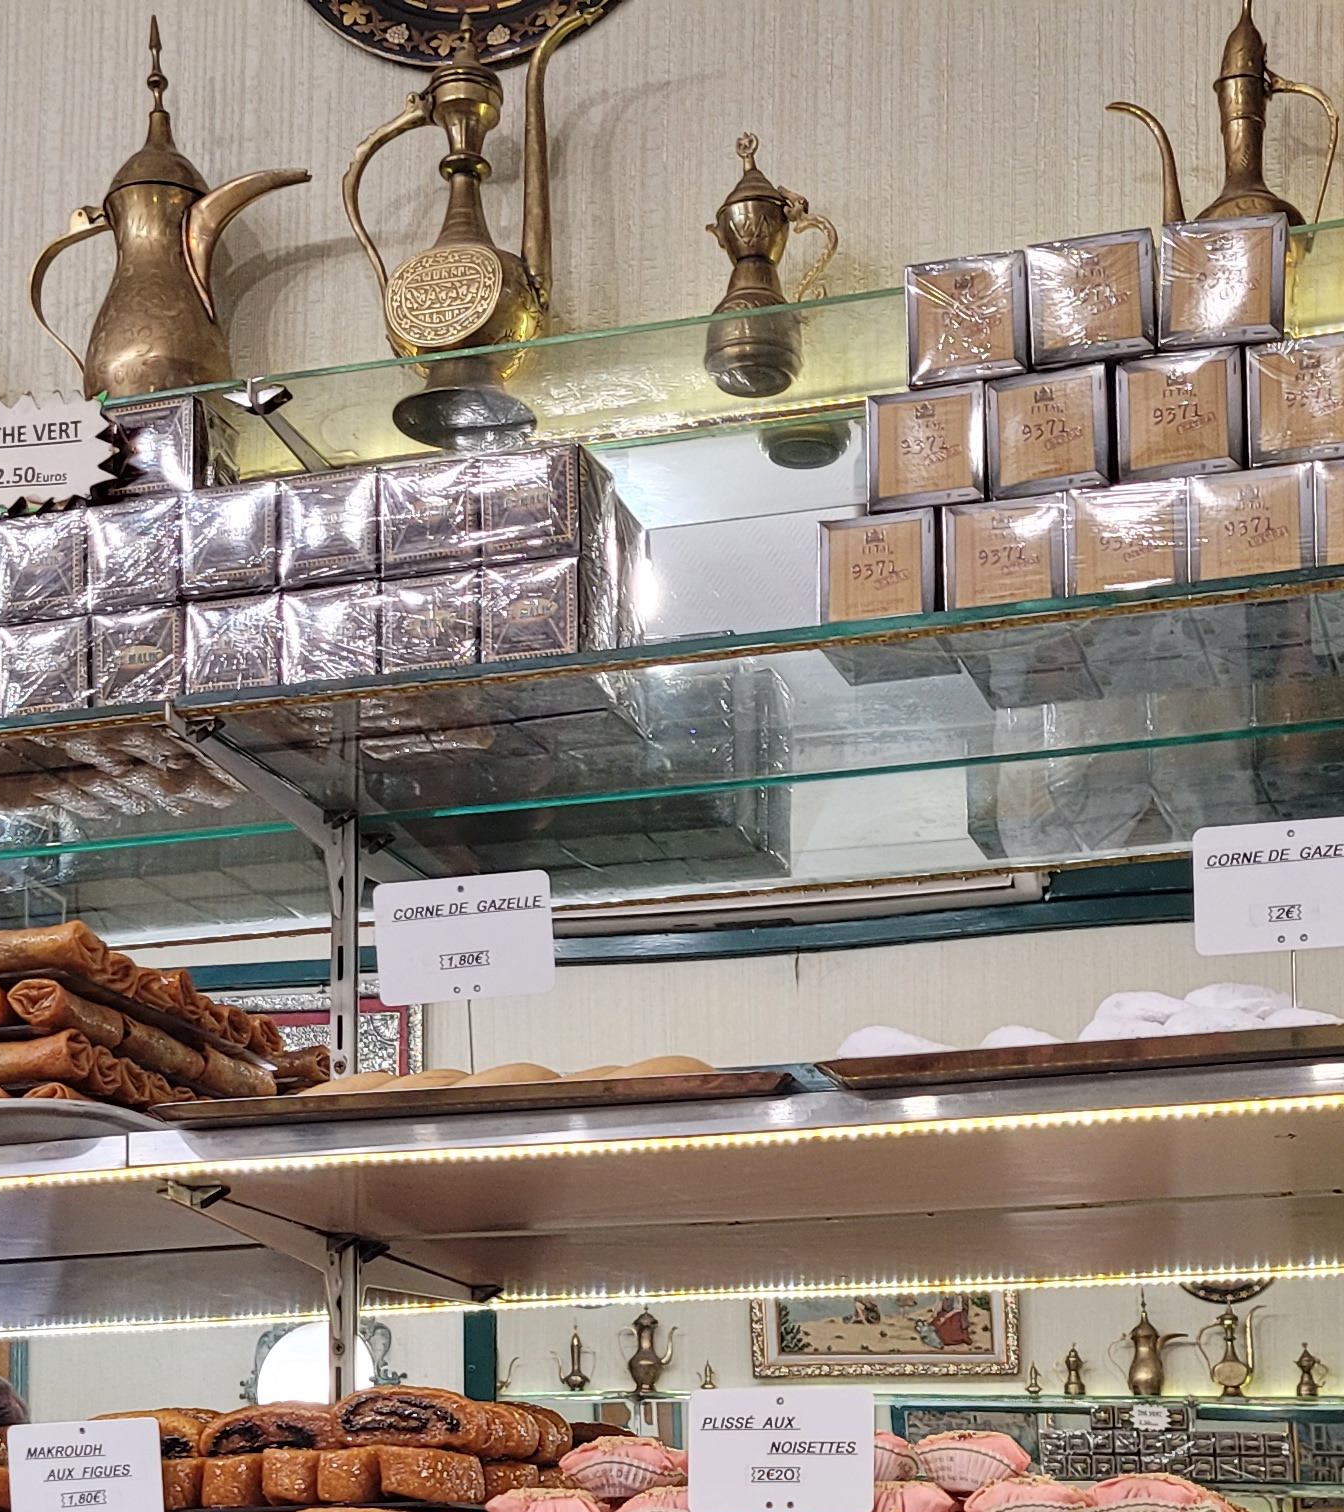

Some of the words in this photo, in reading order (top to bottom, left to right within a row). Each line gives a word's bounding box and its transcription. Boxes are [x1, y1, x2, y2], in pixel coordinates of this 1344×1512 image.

[1154, 403, 1203, 425] 9371
[33, 420, 82, 441] VERT
[1022, 419, 1071, 442] 9371
[852, 559, 897, 580] 9371
[1206, 850, 1265, 868] CORNE
[1268, 848, 1291, 862] DE
[393, 903, 445, 921] CORNE
[448, 902, 470, 915] DE
[477, 895, 543, 914] GAZELLE
[1275, 906, 1296, 920] 2€
[702, 1415, 755, 1430] PLISSÉ
[762, 1416, 796, 1429] AUX
[25, 1443, 103, 1460] MAKROUDH
[769, 1441, 857, 1454] NOISETTES
[46, 1467, 75, 1481] AUX
[82, 1464, 131, 1479] FIGUES
[756, 1468, 796, 1482] 2€20
